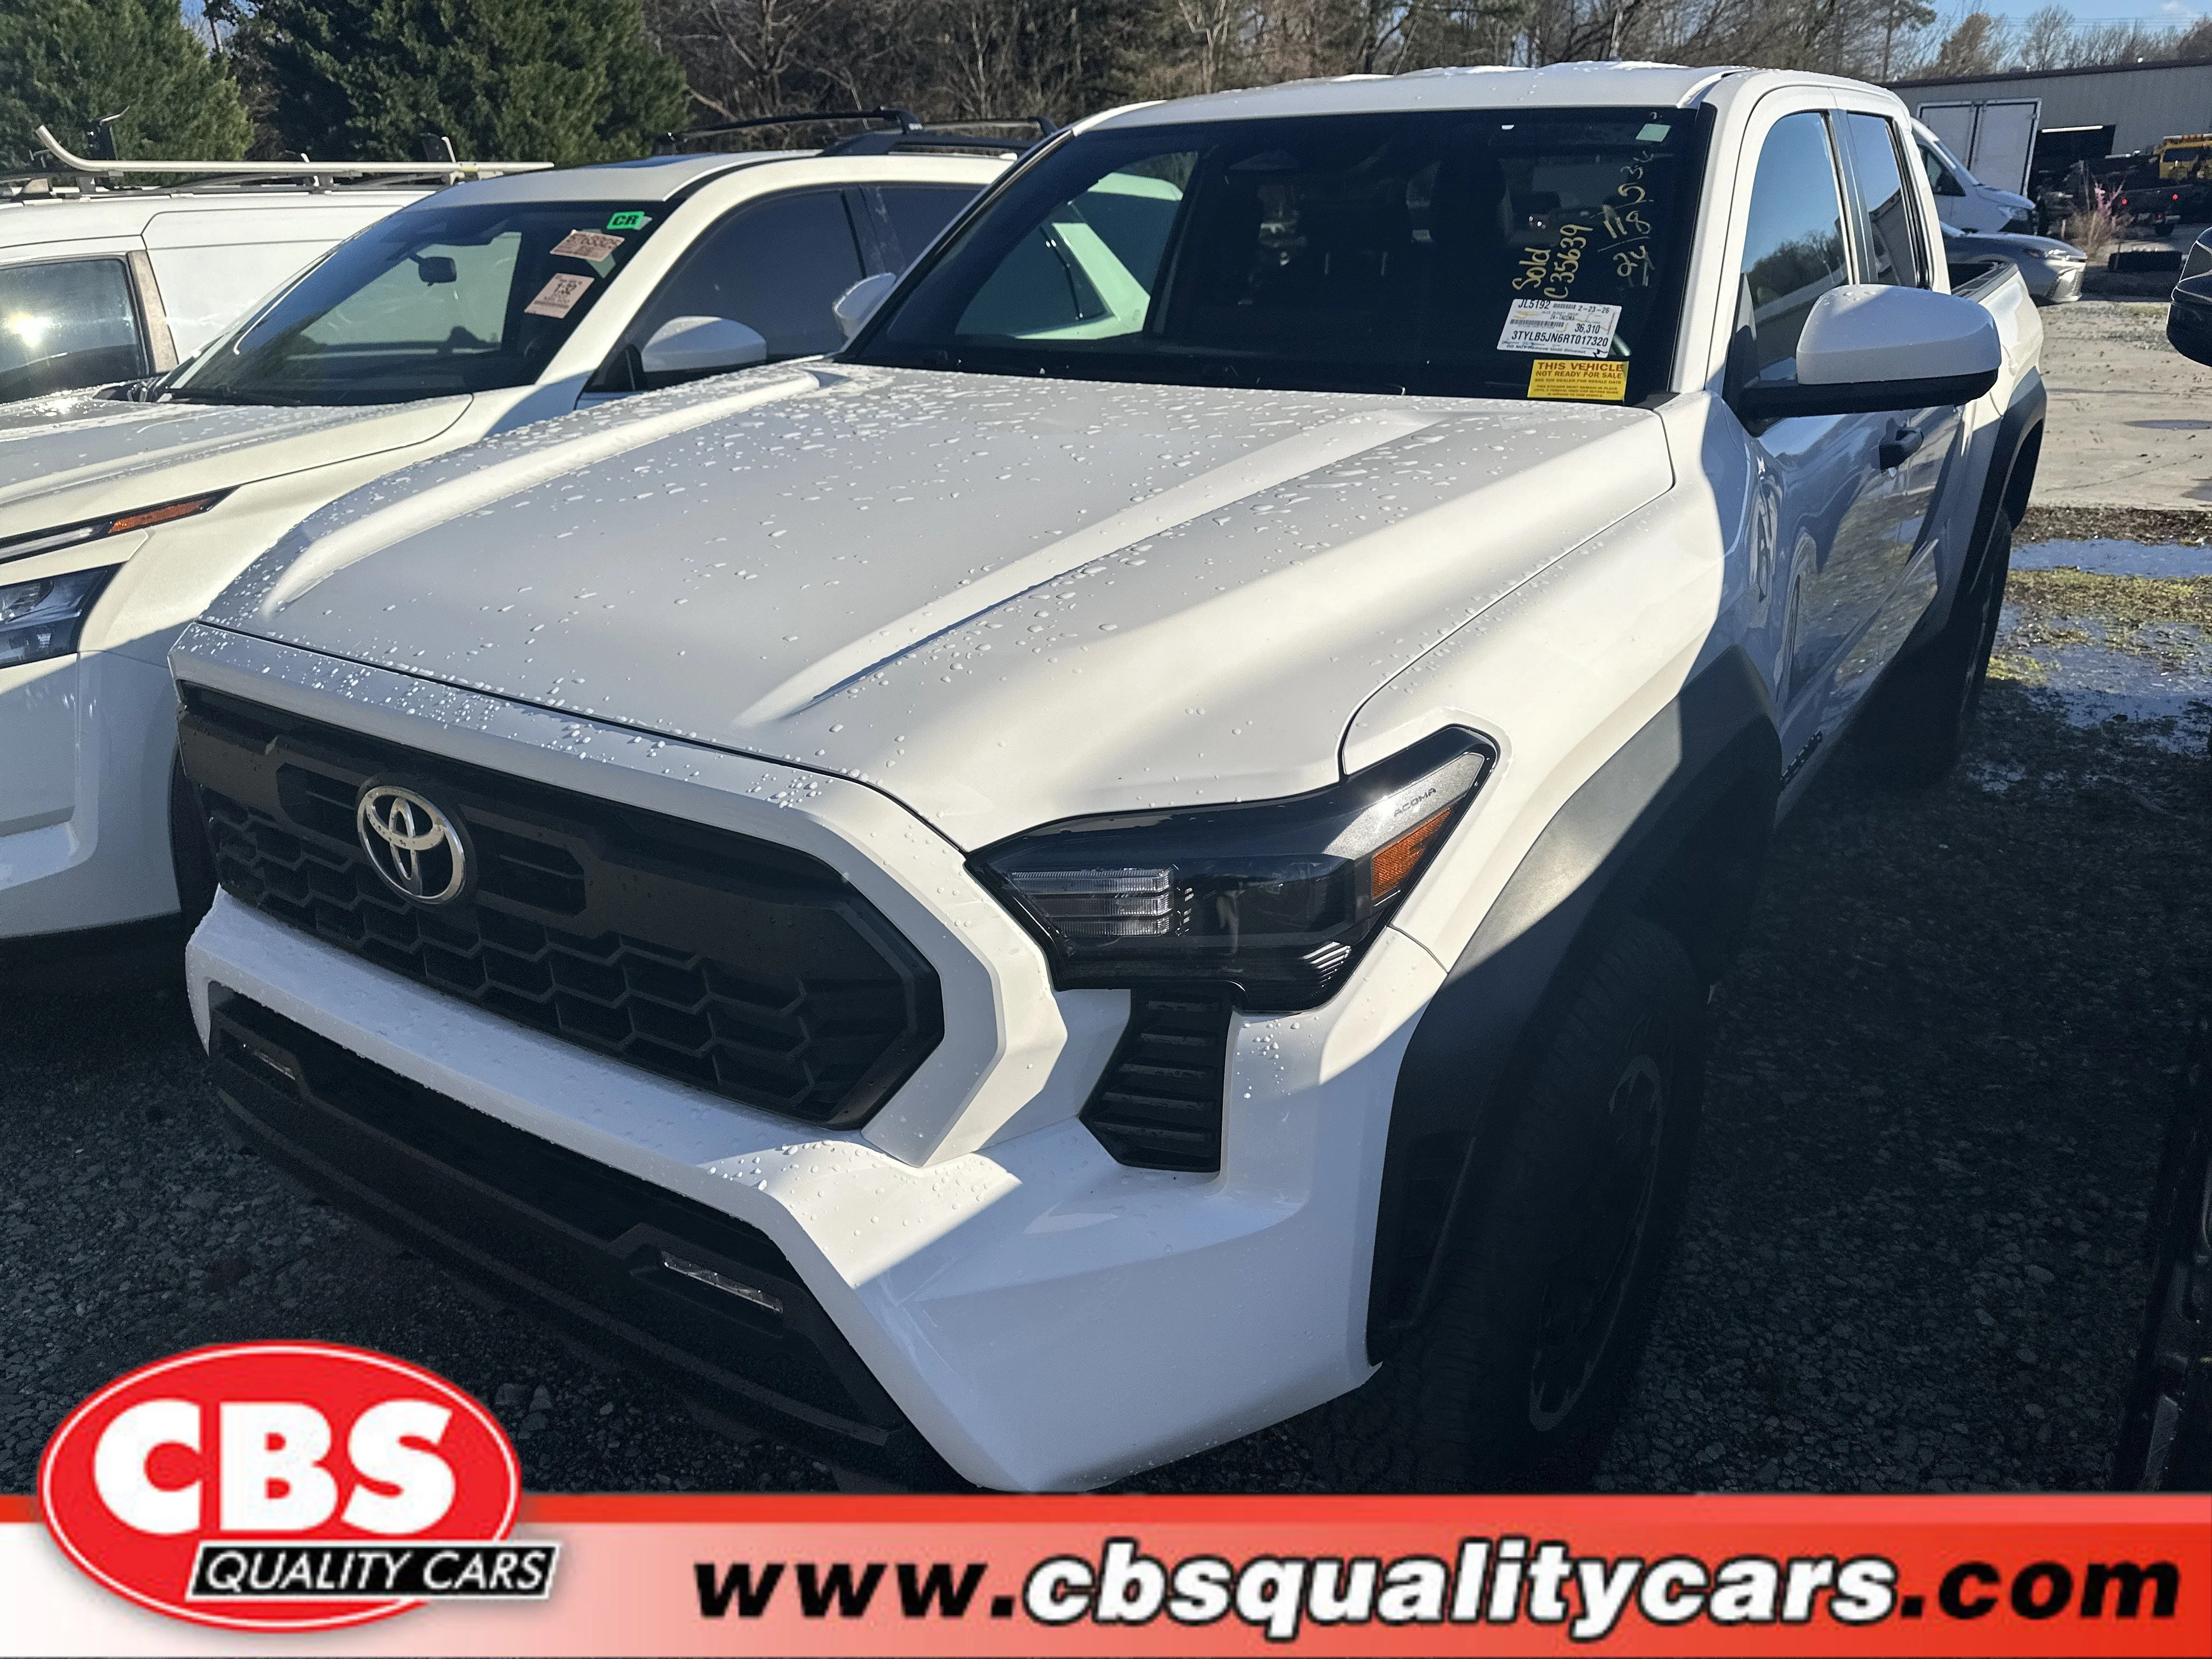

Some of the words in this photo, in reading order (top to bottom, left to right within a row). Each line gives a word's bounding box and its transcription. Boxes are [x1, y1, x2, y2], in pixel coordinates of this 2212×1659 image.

[612, 215, 639, 226] CR
[1512, 247, 1551, 290] Sold
[1519, 300, 1550, 309] JL5192
[1575, 323, 1600, 334] 36,310
[1511, 331, 1609, 347] 3TYLB5JN6RT017320
[1538, 362, 1566, 370] THIS
[1571, 363, 1623, 372] VEHICLE
[1393, 787, 1436, 817] ACOMA
